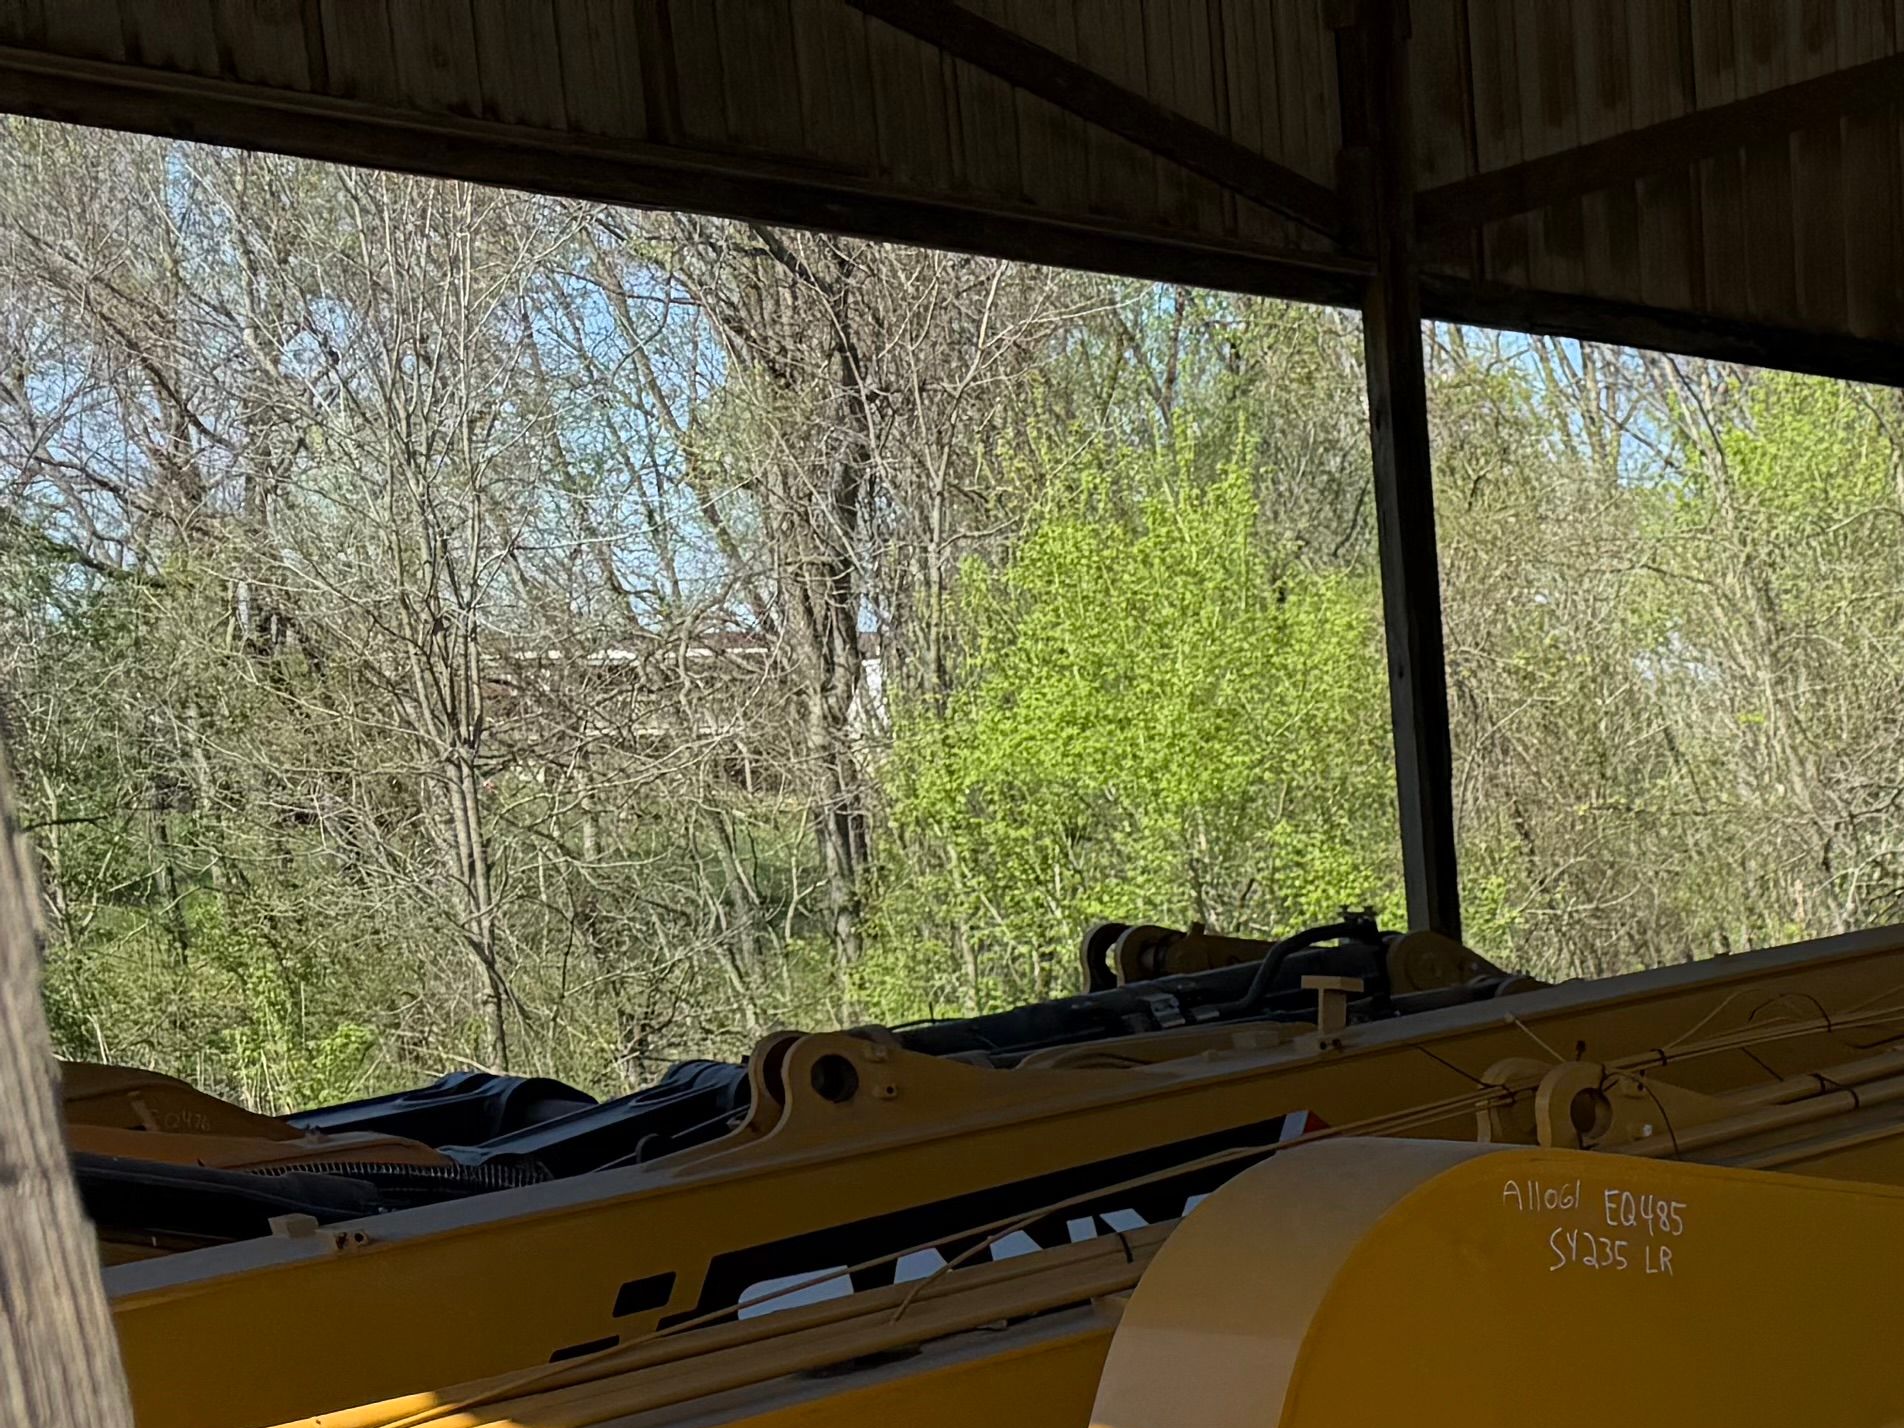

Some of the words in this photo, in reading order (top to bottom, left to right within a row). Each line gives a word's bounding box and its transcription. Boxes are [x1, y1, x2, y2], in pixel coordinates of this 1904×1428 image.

[1603, 1188, 1688, 1237] EQ485
[1548, 1226, 1629, 1272] SY235
[1645, 1245, 1674, 1278] LR
